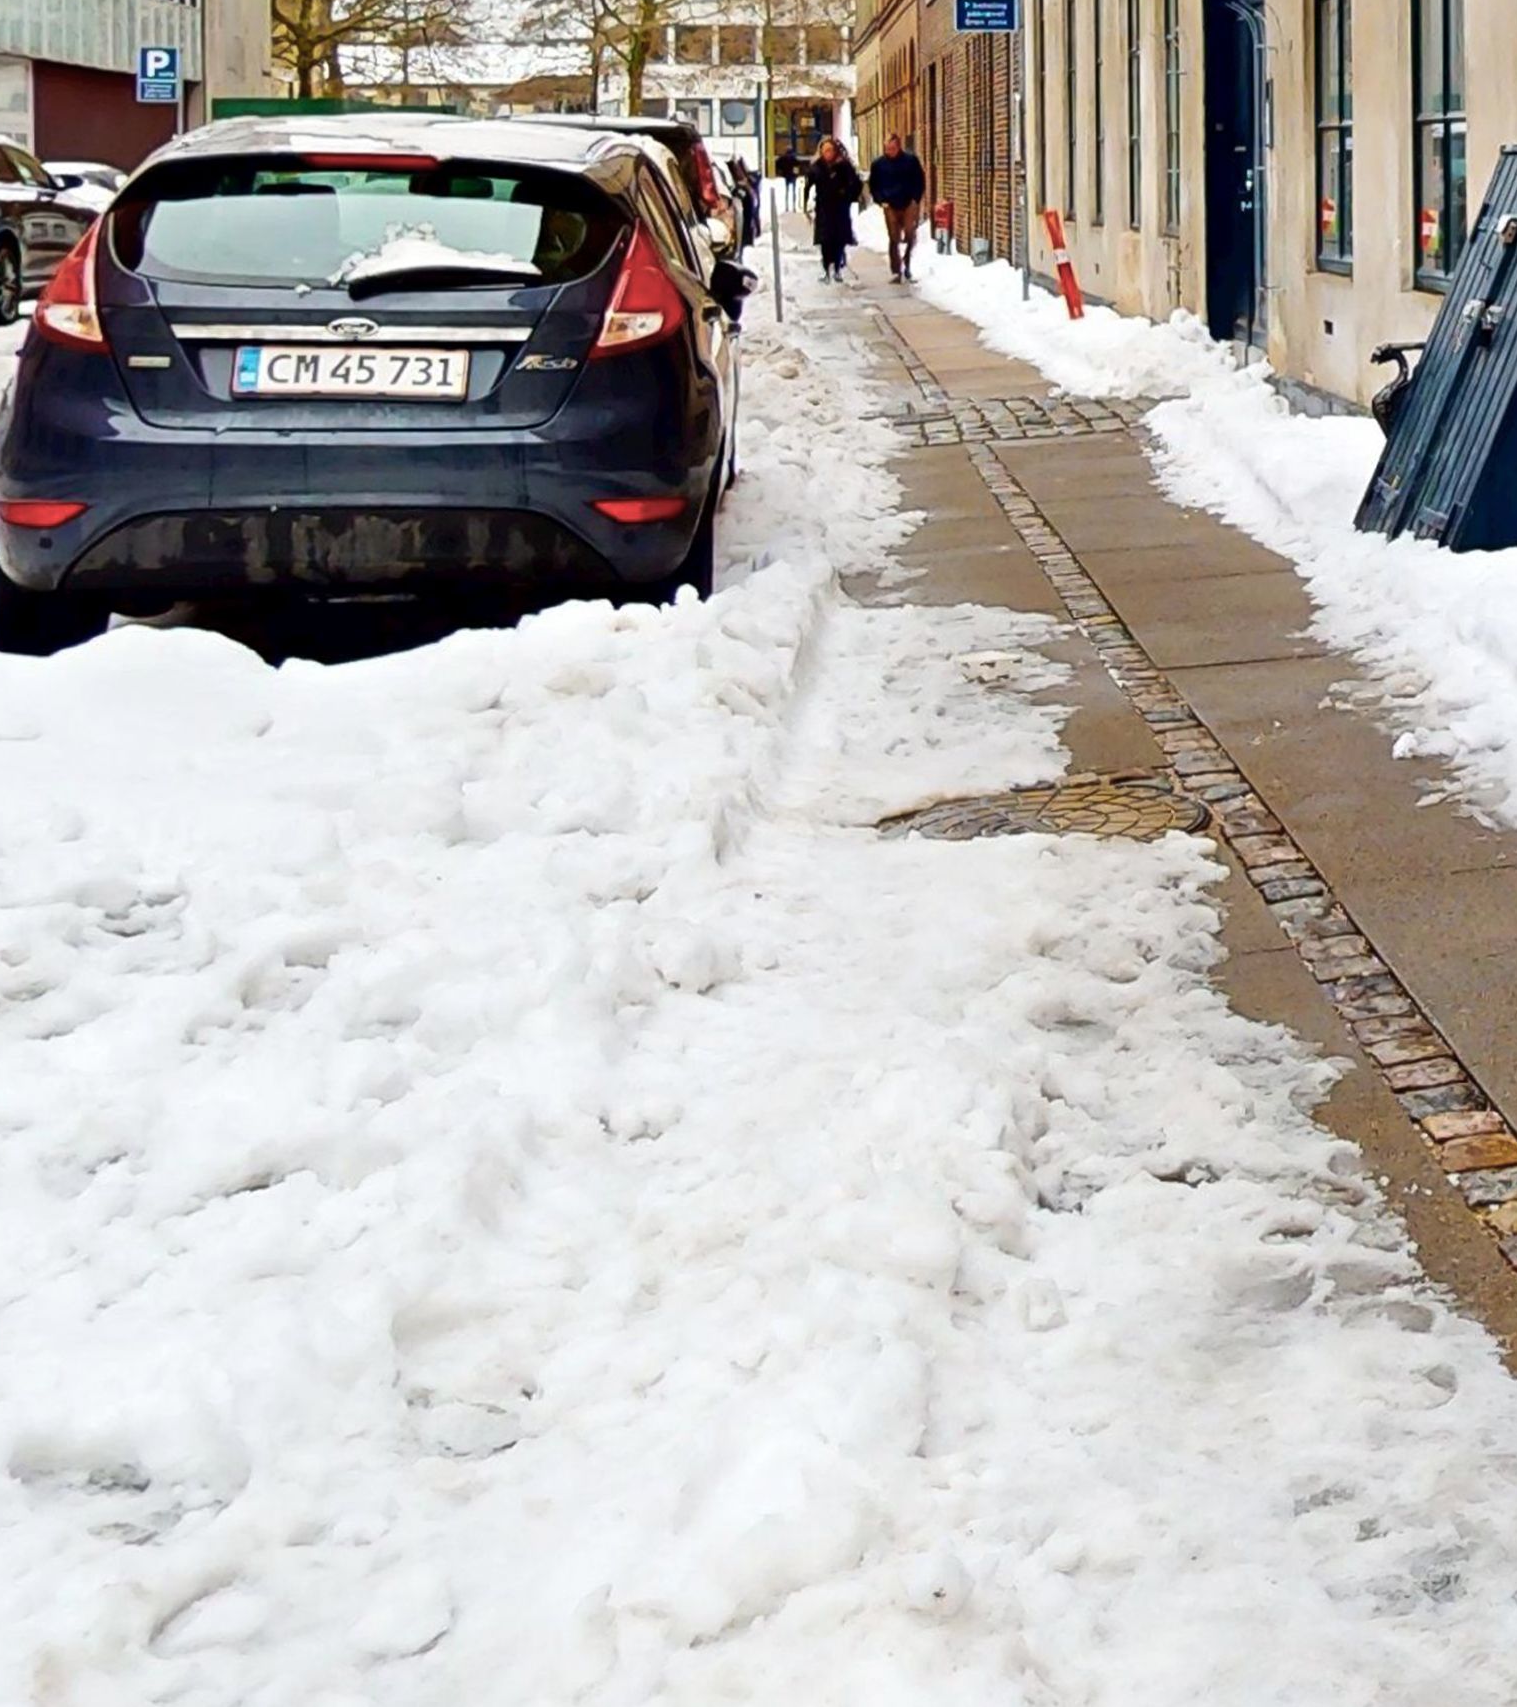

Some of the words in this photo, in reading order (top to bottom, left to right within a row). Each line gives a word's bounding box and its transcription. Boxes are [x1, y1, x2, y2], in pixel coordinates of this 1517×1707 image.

[147, 51, 170, 77] P
[267, 354, 319, 385] CM
[331, 355, 376, 384] 45
[390, 355, 454, 387] 731
